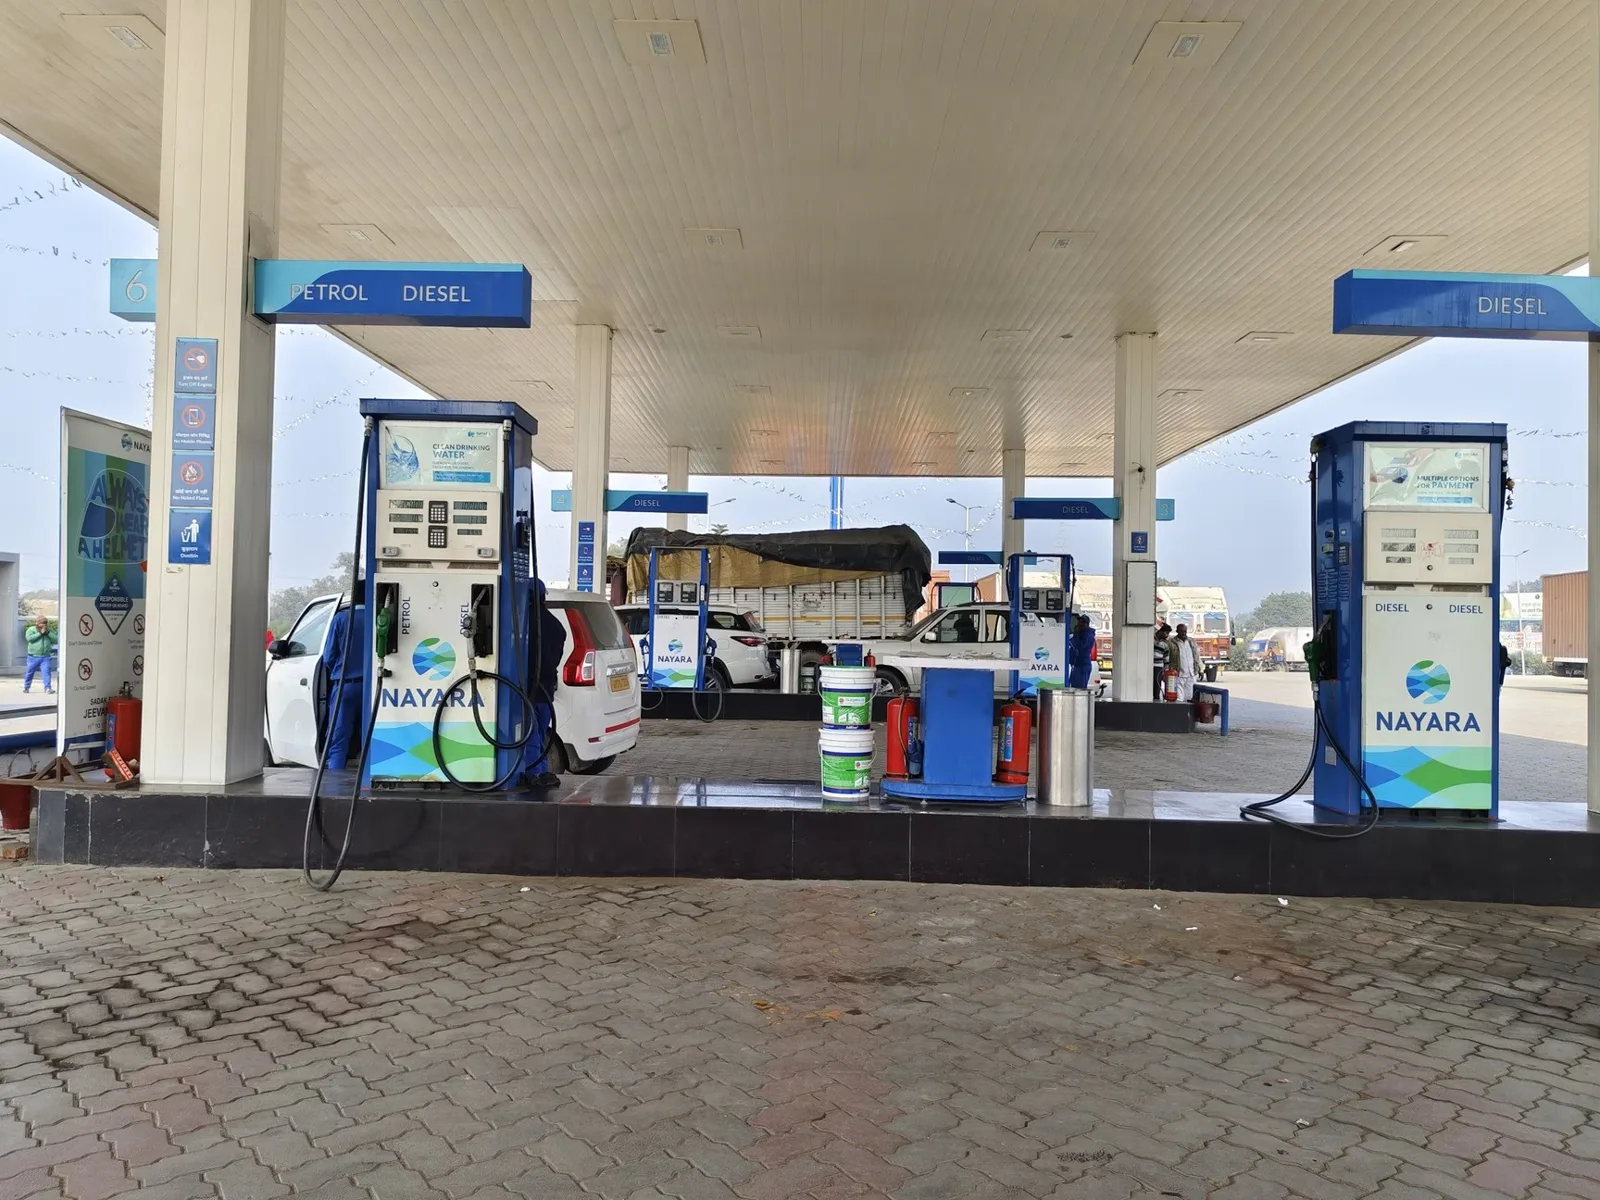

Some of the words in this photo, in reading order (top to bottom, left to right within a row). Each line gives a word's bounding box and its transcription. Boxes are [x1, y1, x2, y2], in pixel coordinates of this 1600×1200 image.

[126, 269, 148, 303] 6
[289, 283, 368, 302] PETROL
[402, 284, 471, 303] DIESEL
[1478, 296, 1548, 316] DIESEL
[432, 450, 465, 459] WATER
[91, 472, 148, 514] ALWAYS
[1062, 506, 1089, 514] DIESEL
[1160, 504, 1169, 516] 3
[78, 537, 91, 558] A
[92, 534, 148, 561] HELMET
[1375, 603, 1410, 612] DIESEL
[1449, 605, 1483, 614] DIESEL
[402, 597, 411, 635] PETROL
[657, 655, 693, 664] NAYARA
[90, 697, 107, 705] SADAK
[382, 688, 485, 708] NAYARA
[83, 707, 108, 719] JEEVA
[1376, 711, 1481, 732] NAYARA
